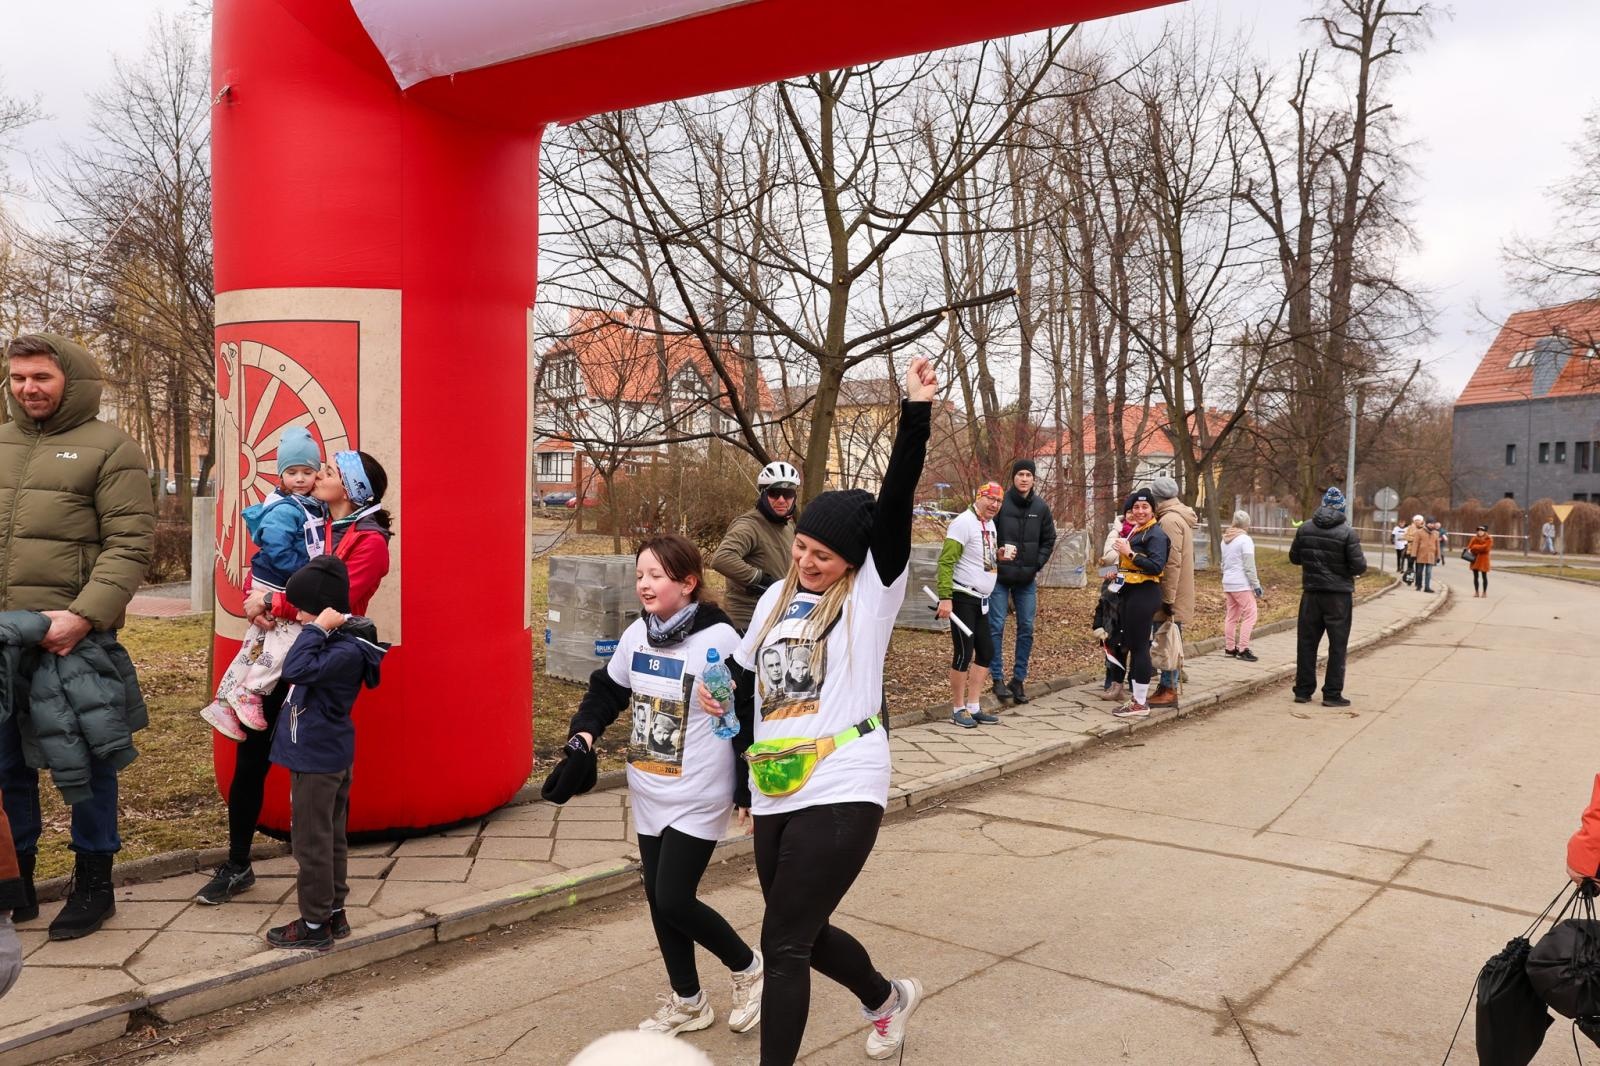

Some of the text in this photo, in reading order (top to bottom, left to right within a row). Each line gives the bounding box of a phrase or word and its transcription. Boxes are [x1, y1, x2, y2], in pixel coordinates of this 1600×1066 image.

[56, 451, 78, 459] FILA
[787, 604, 799, 616] 19
[648, 658, 660, 671] 18
